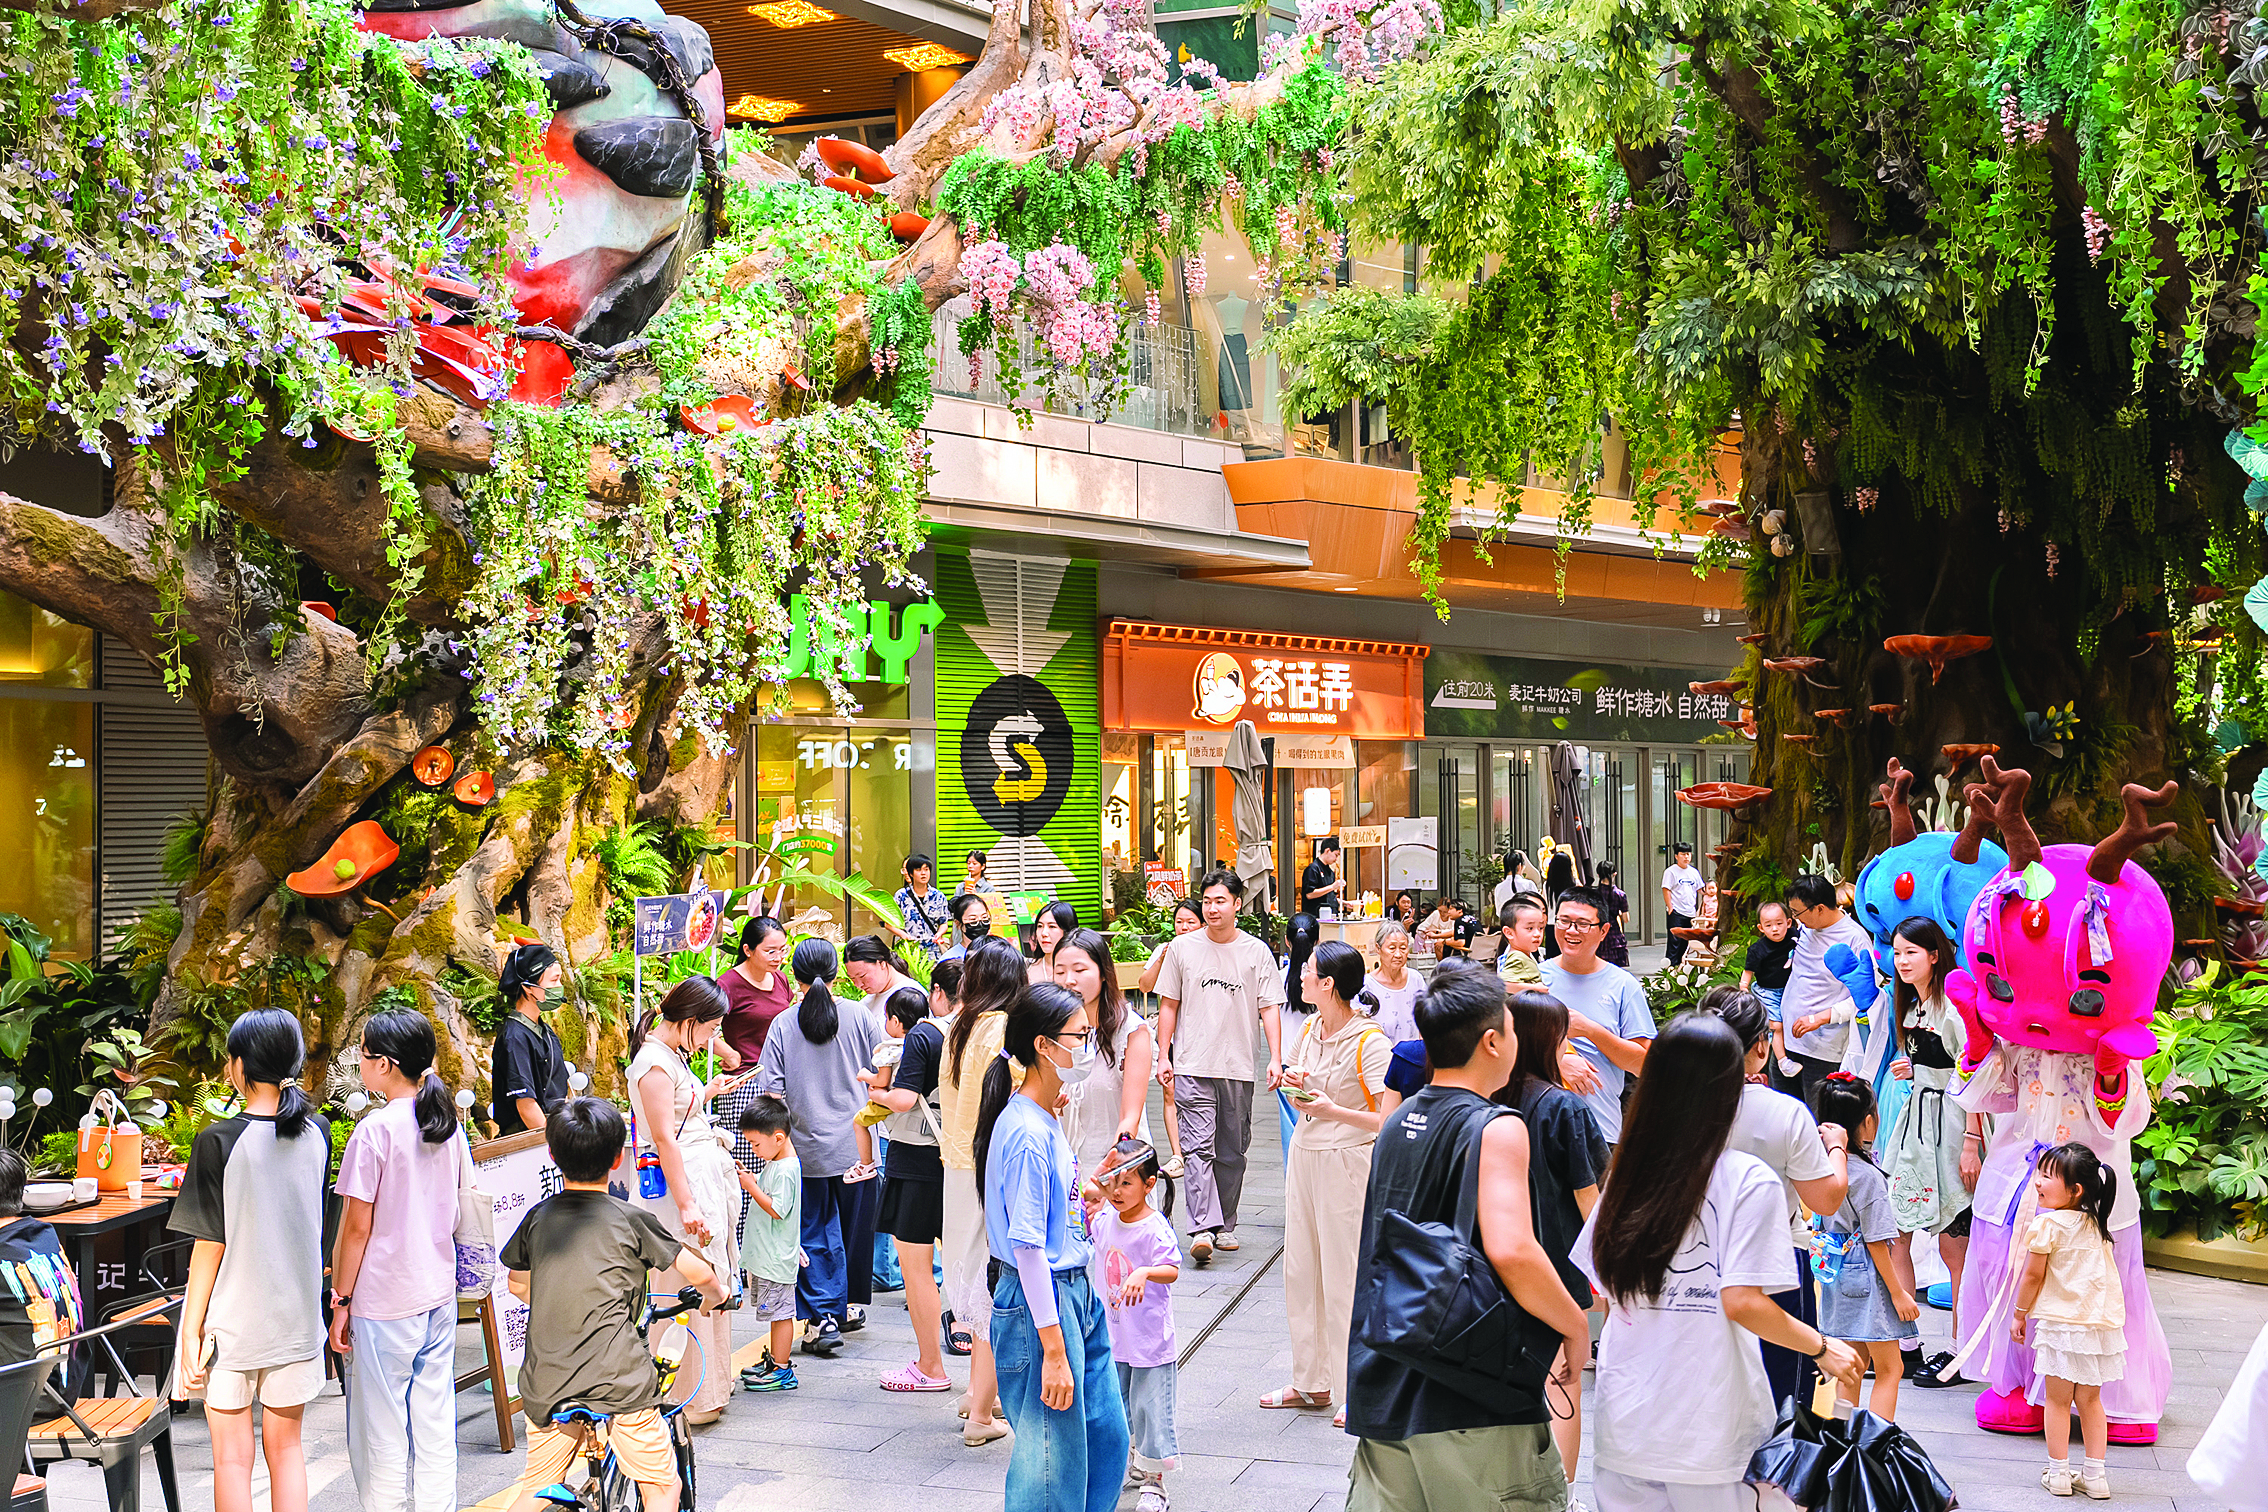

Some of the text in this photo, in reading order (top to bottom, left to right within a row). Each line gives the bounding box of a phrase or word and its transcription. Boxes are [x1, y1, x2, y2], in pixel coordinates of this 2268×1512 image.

[1250, 659, 1354, 711] 茶话弄
[1444, 679, 1496, 699] 往前20米
[1508, 683, 1583, 706] 麦记牛奶公司
[1595, 686, 1730, 720] 鲜作糖水 自然甜
[887, 1381, 915, 1391] crocs
